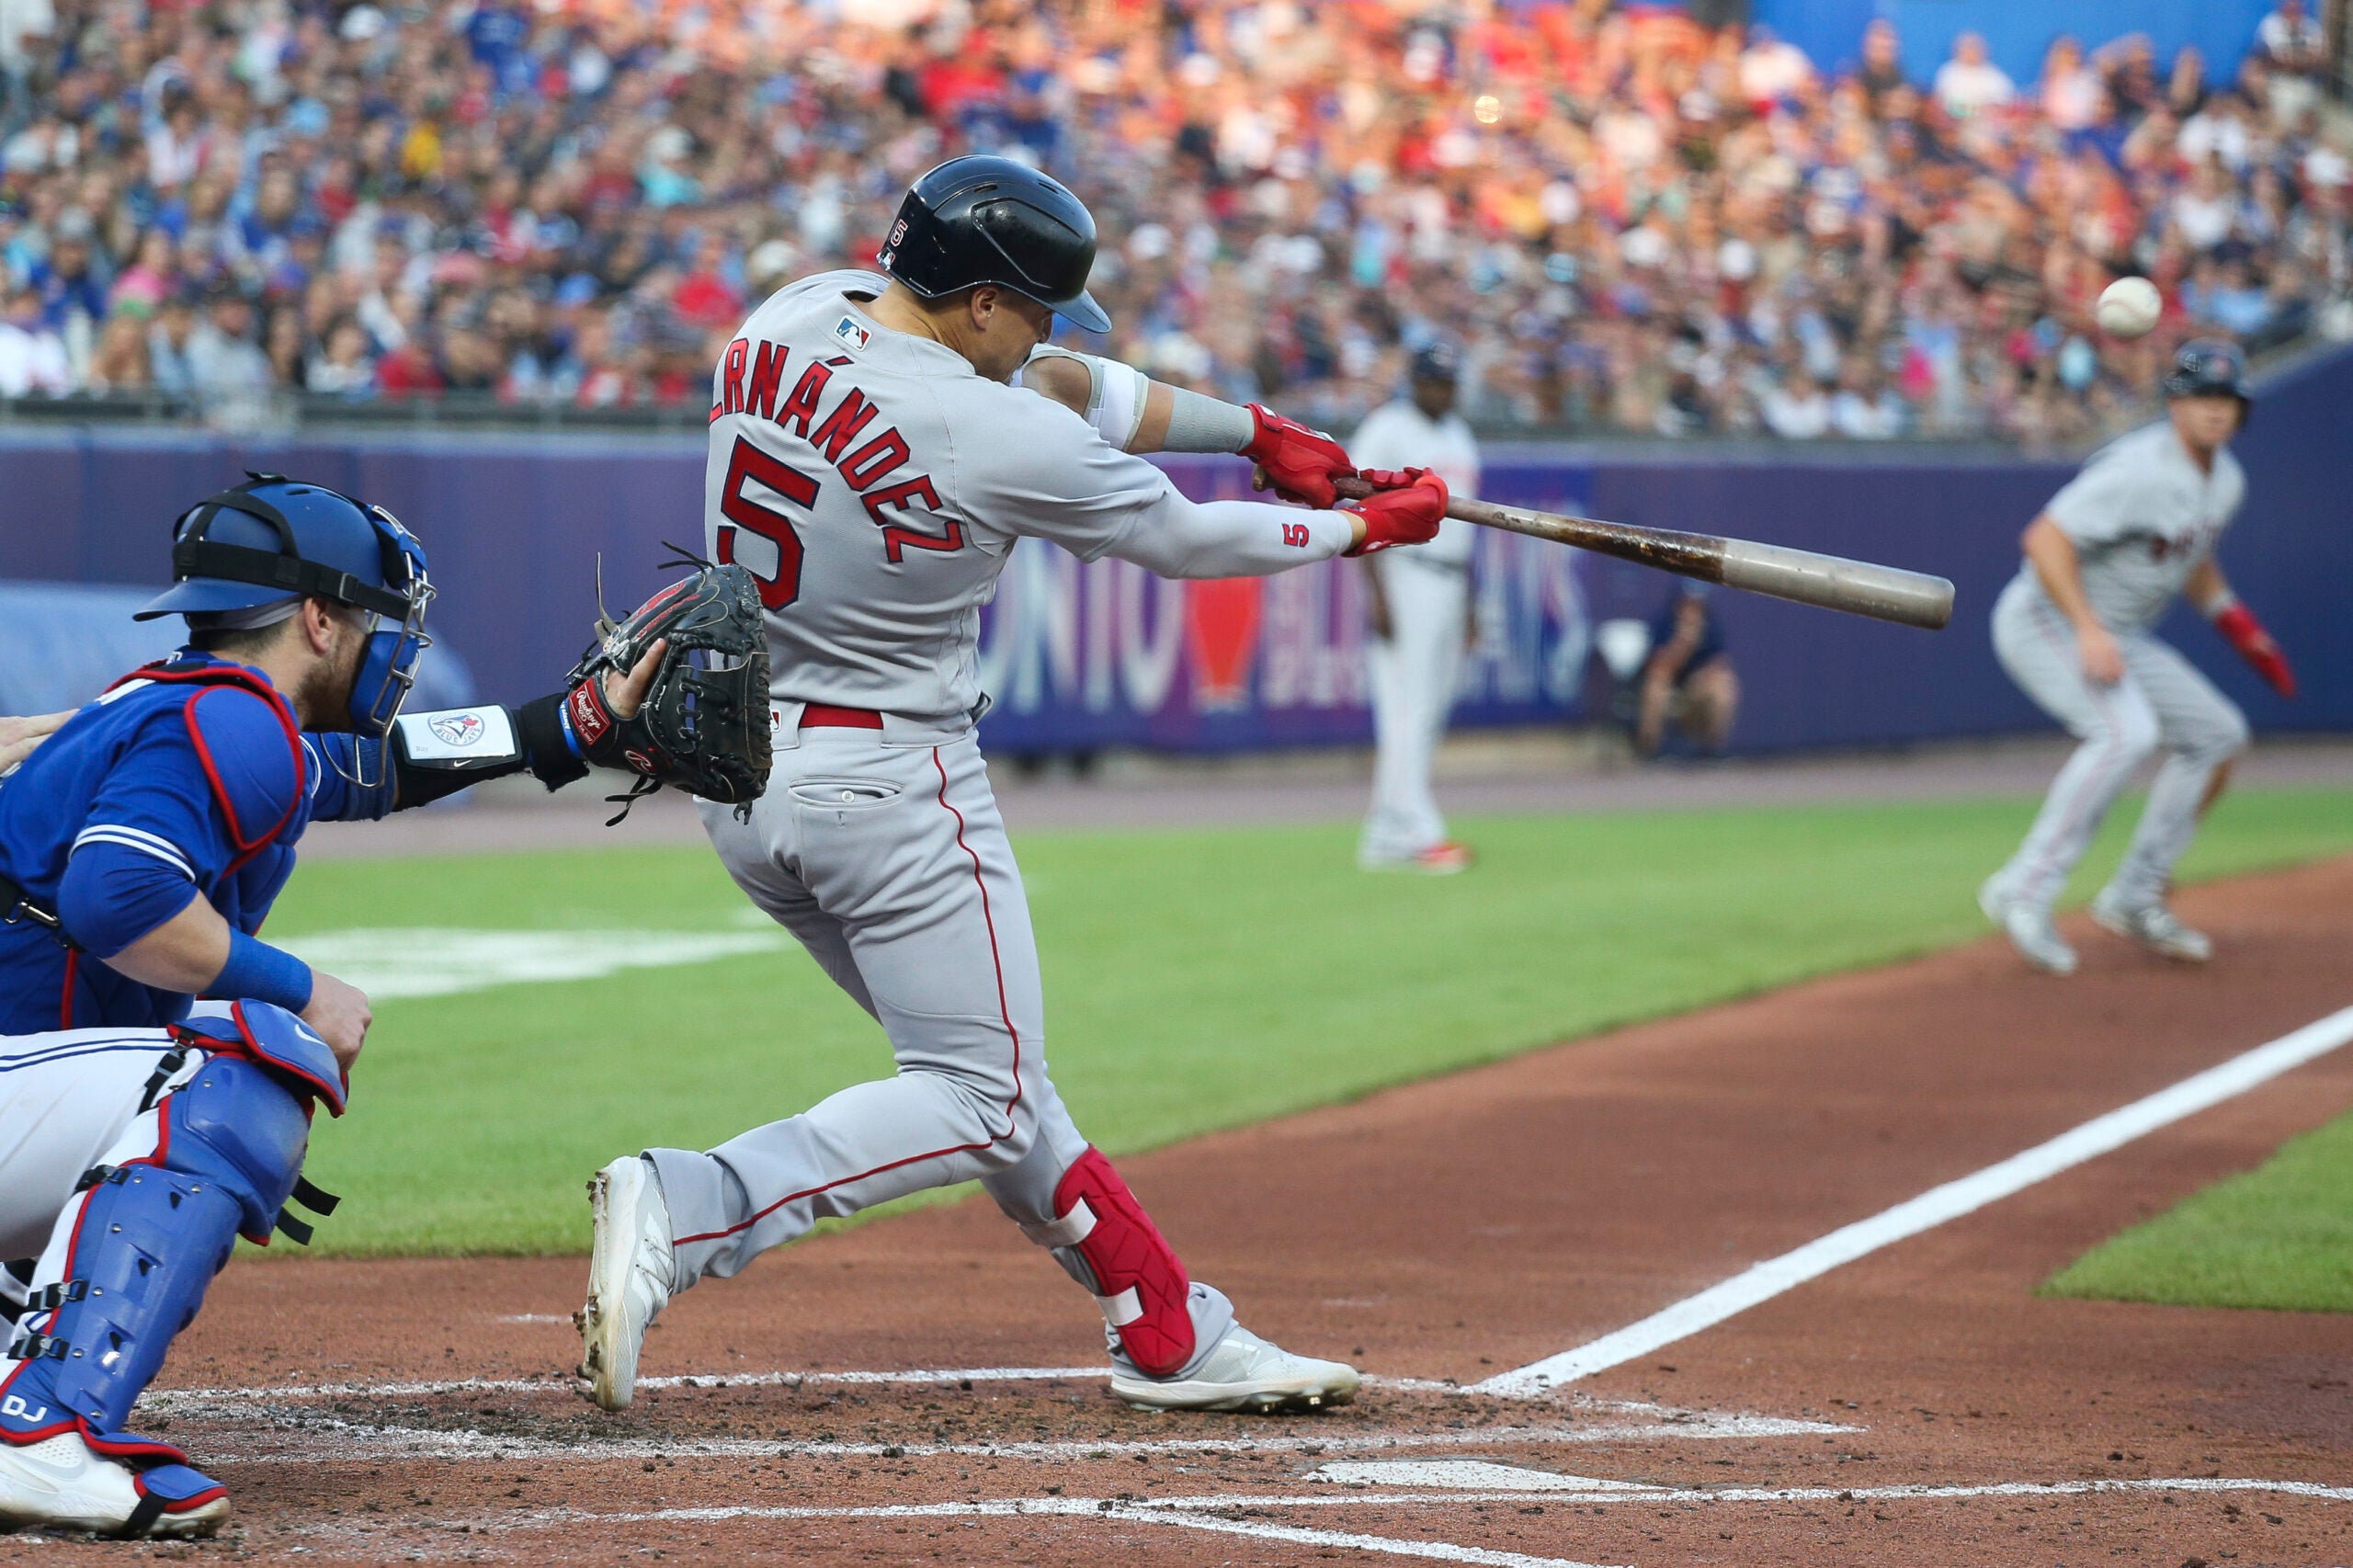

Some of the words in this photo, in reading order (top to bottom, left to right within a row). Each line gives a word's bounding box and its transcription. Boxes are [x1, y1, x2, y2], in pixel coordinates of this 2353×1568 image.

[890, 219, 908, 246] 5
[709, 337, 965, 563] RNÁNDEZ
[717, 435, 822, 613] 5
[1281, 523, 1310, 548] 5
[576, 690, 601, 729] Rawlings
[436, 728, 459, 744] BLUE
[463, 727, 481, 744] JAYS
[1, 1394, 48, 1423] DJ
